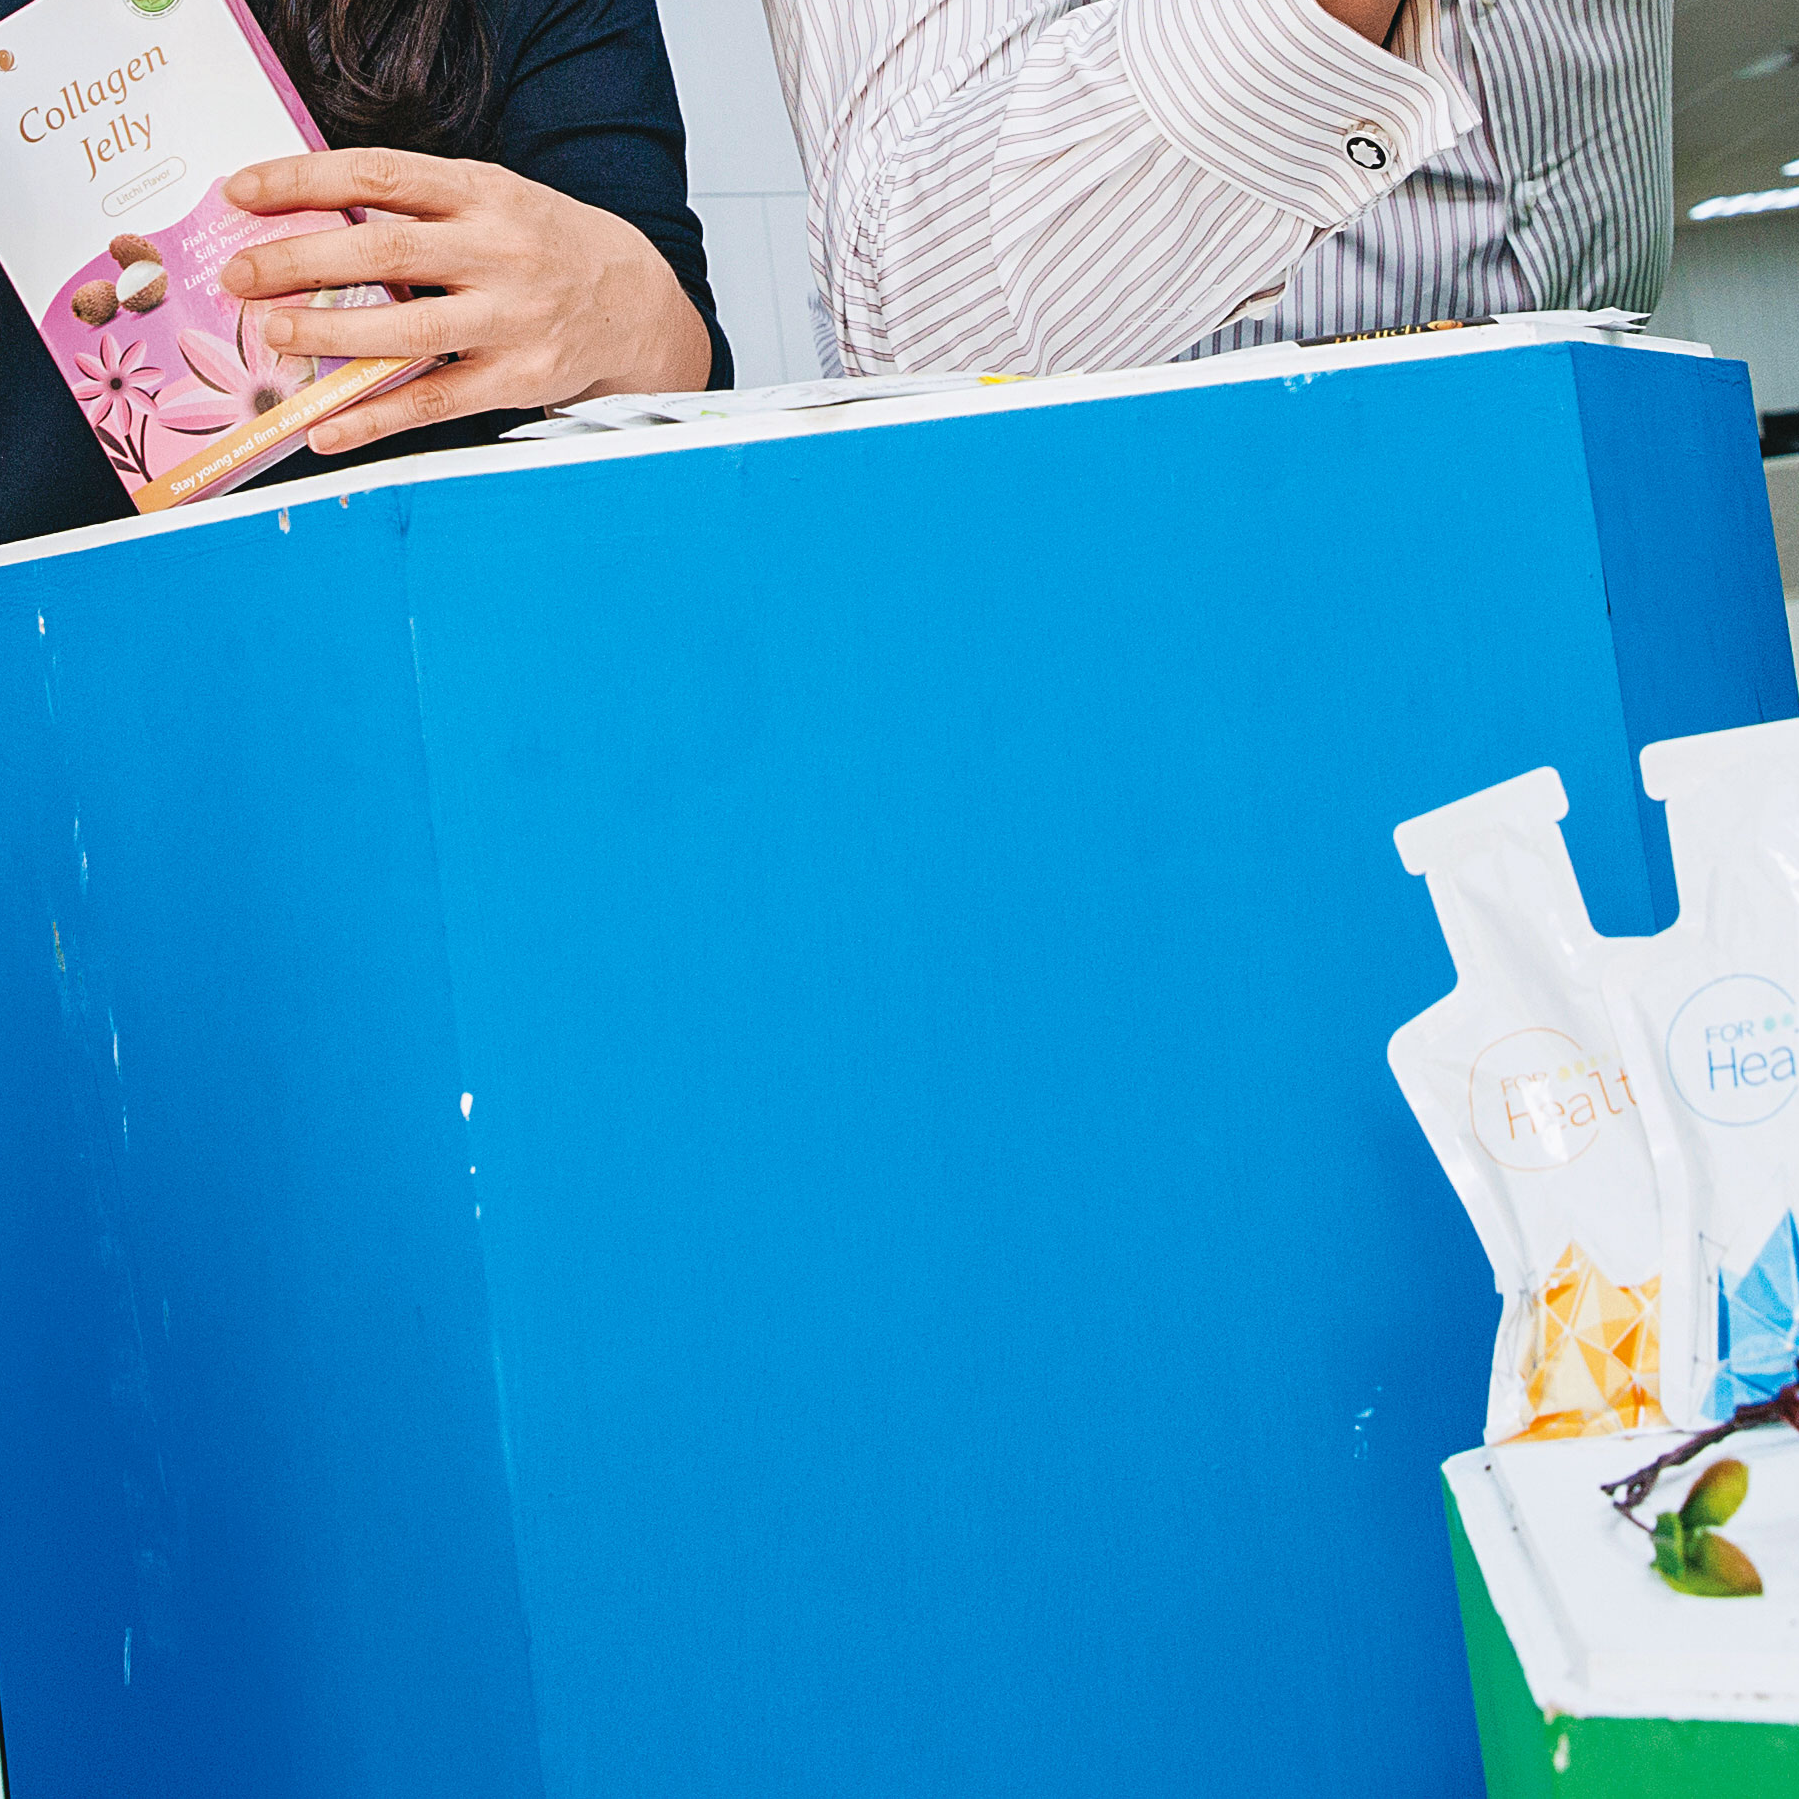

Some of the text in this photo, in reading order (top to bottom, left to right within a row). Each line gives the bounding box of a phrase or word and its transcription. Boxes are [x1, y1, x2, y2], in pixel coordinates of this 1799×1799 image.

[19, 44, 169, 143] Collagen
[80, 113, 152, 183] Jelly
[116, 168, 172, 206] Litchi Flavor
[182, 210, 247, 252] Fish Collag
[195, 218, 262, 264] Silk Protein
[183, 263, 219, 291] Litchi
[170, 475, 197, 496] Stay
[195, 453, 234, 488] young
[232, 439, 254, 458] and
[253, 424, 280, 448] firm
[278, 410, 303, 431] skin
[302, 402, 317, 418] as
[315, 387, 338, 412] you
[336, 377, 364, 397] ever
[1705, 1020, 1755, 1045] FOR
[1504, 1067, 1637, 1140] Healt
